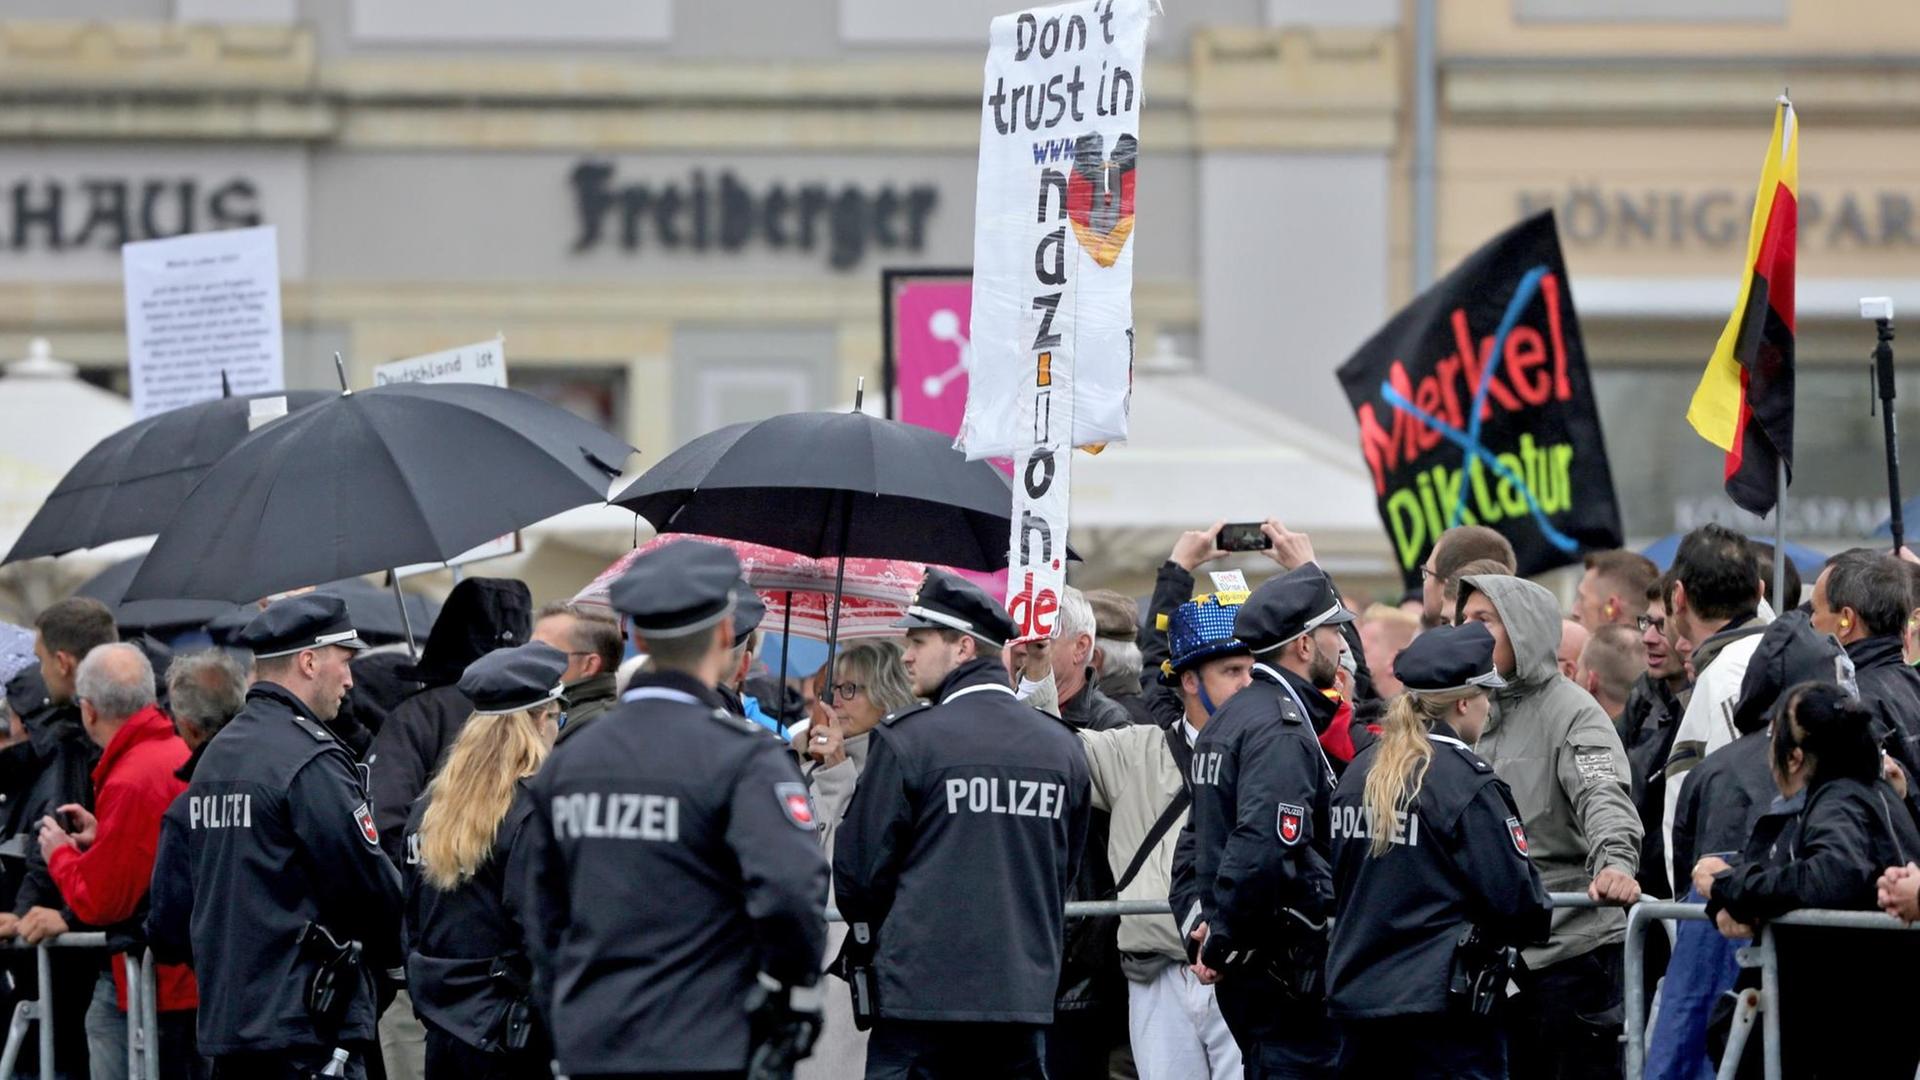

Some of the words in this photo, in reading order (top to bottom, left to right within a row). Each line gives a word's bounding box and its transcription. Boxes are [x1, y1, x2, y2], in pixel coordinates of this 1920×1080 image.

[1014, 0, 1115, 61] Don't
[988, 65, 1085, 135] trust
[1096, 60, 1134, 116] in
[0, 176, 262, 251] HAUS
[568, 157, 938, 269] Freiberger
[475, 350, 494, 369] ist
[1359, 274, 1572, 496] Merkel
[551, 792, 680, 842] POLIZEI
[946, 776, 1066, 820] POLIZEI
[1330, 806, 1419, 847] POLIEI
